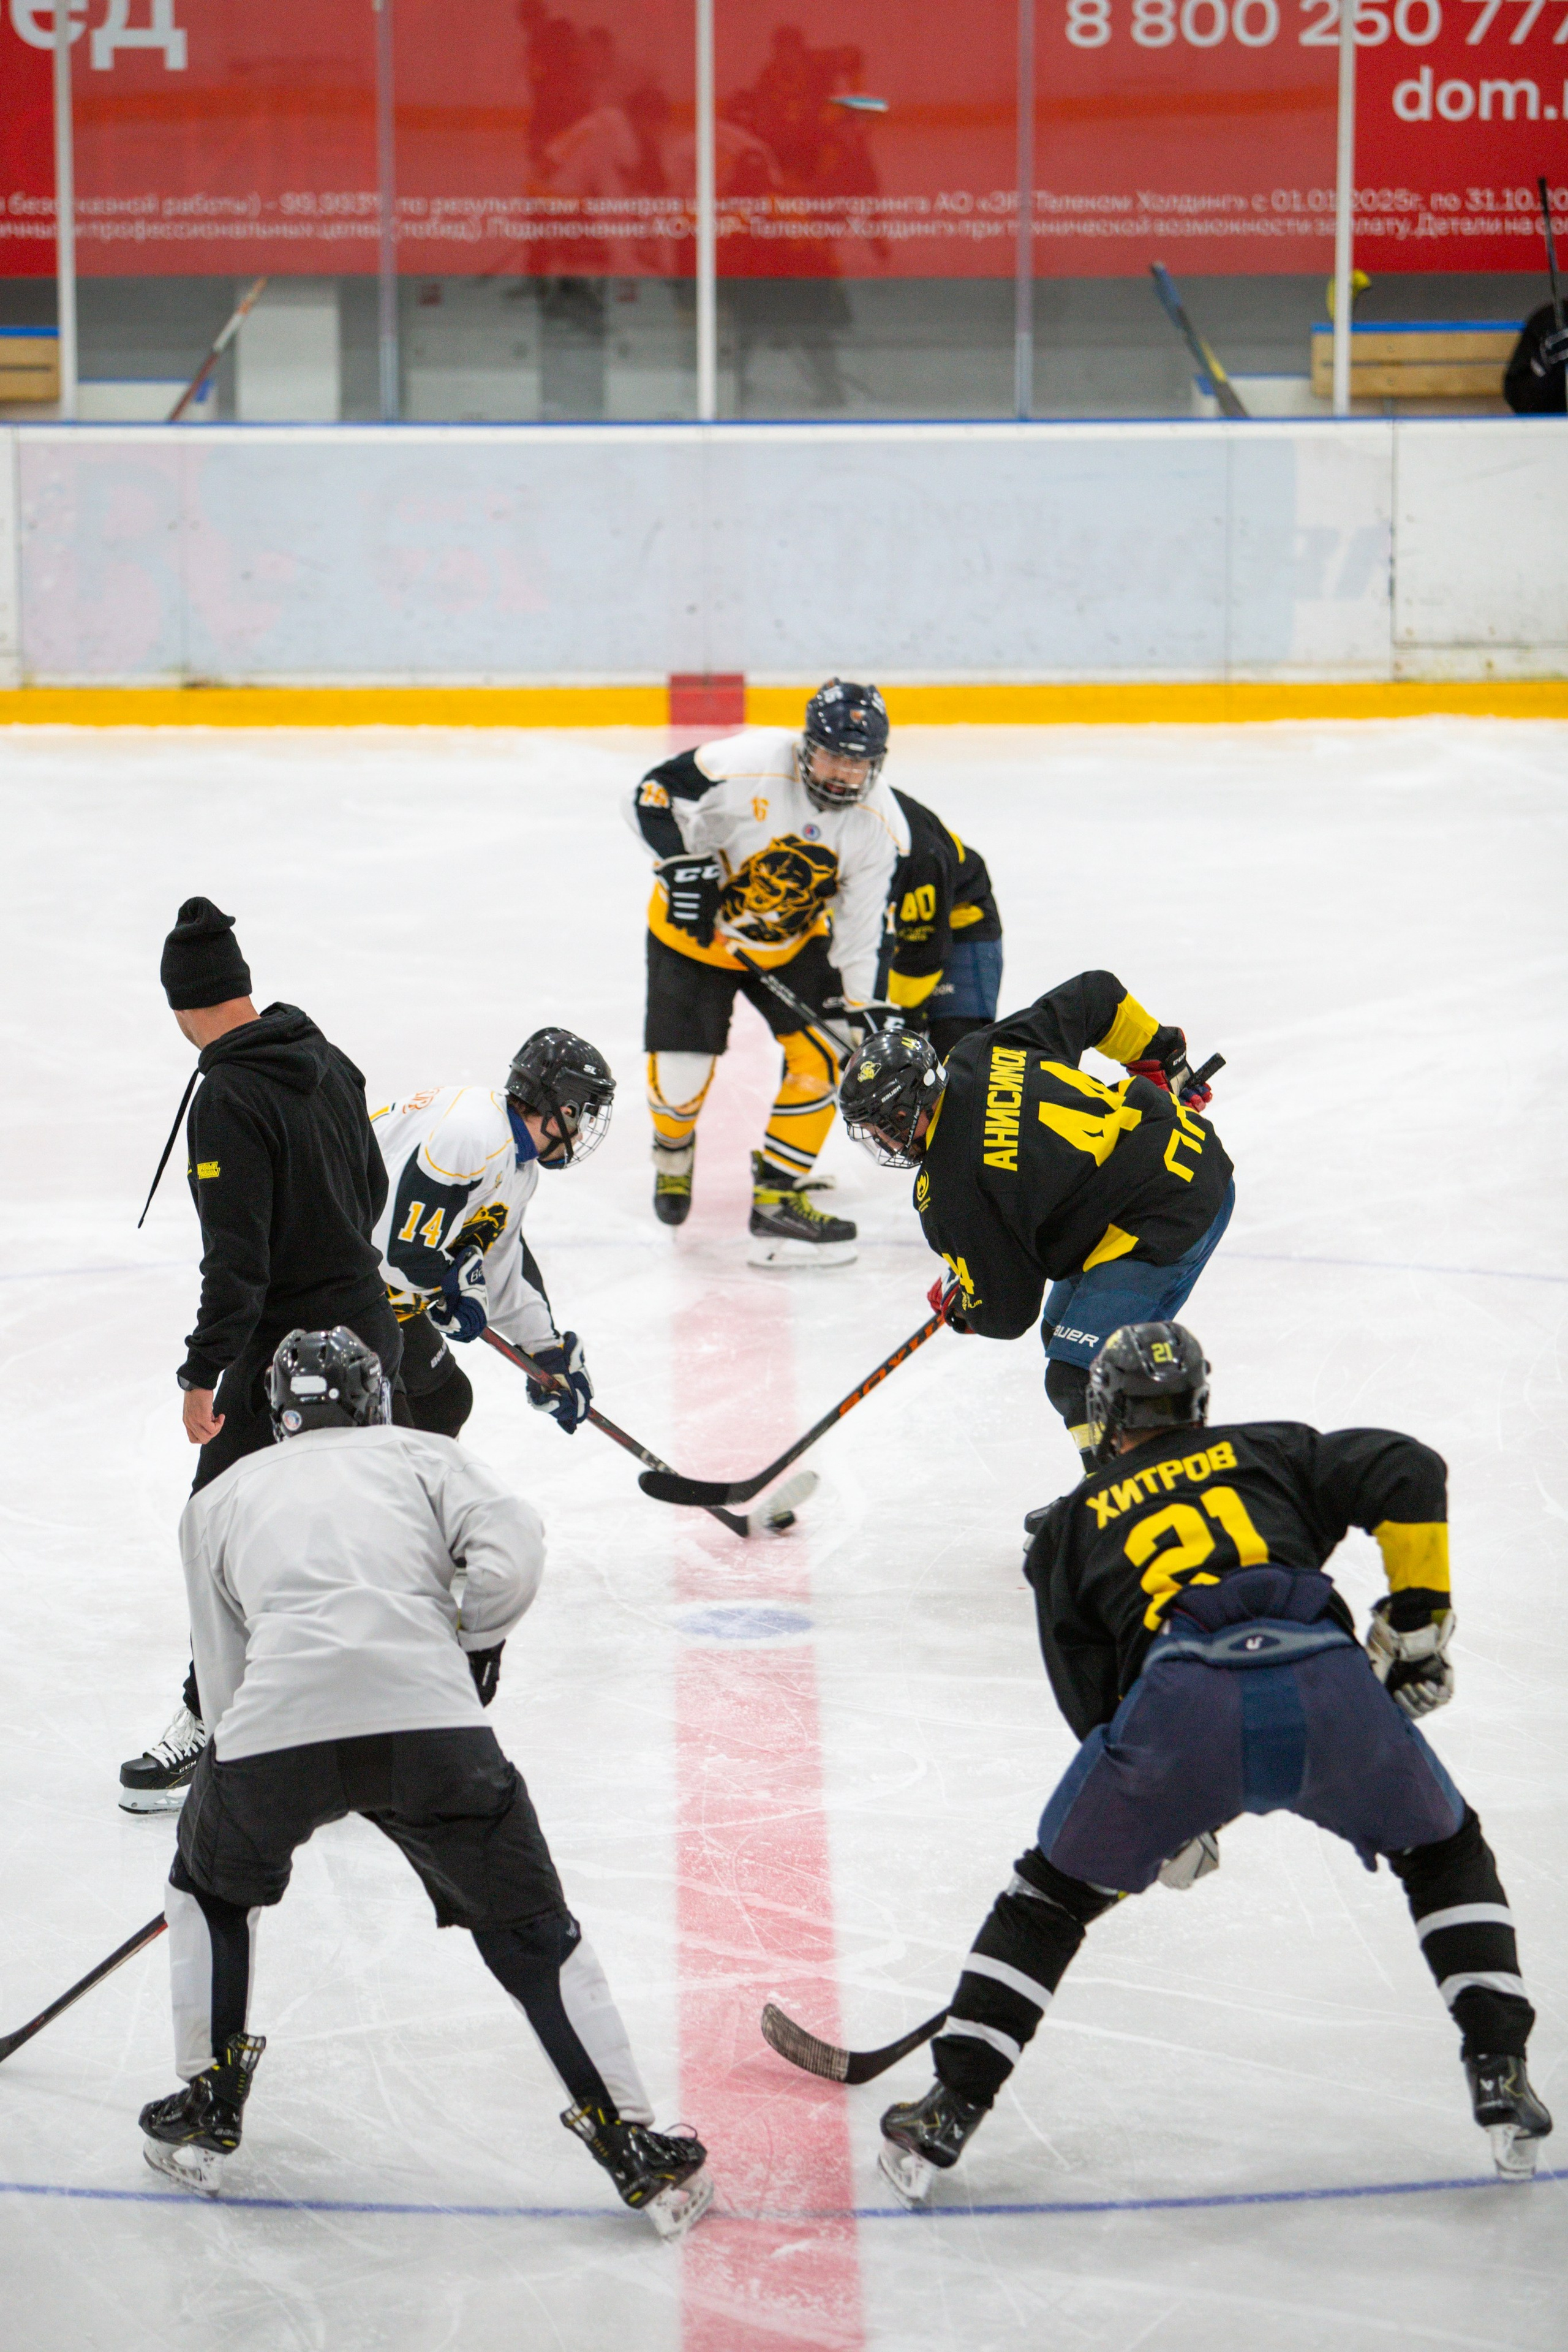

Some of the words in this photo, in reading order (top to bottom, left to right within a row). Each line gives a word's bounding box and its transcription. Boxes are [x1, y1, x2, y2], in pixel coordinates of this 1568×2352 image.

[1130, 0, 1281, 48] 800
[1392, 65, 1568, 122] dom.
[900, 883, 936, 922] 40
[398, 1201, 445, 1248] 14
[1151, 1342, 1174, 1363] 21
[1085, 1441, 1238, 1530] ХИТРОВ
[1123, 1485, 1270, 1632] 21
